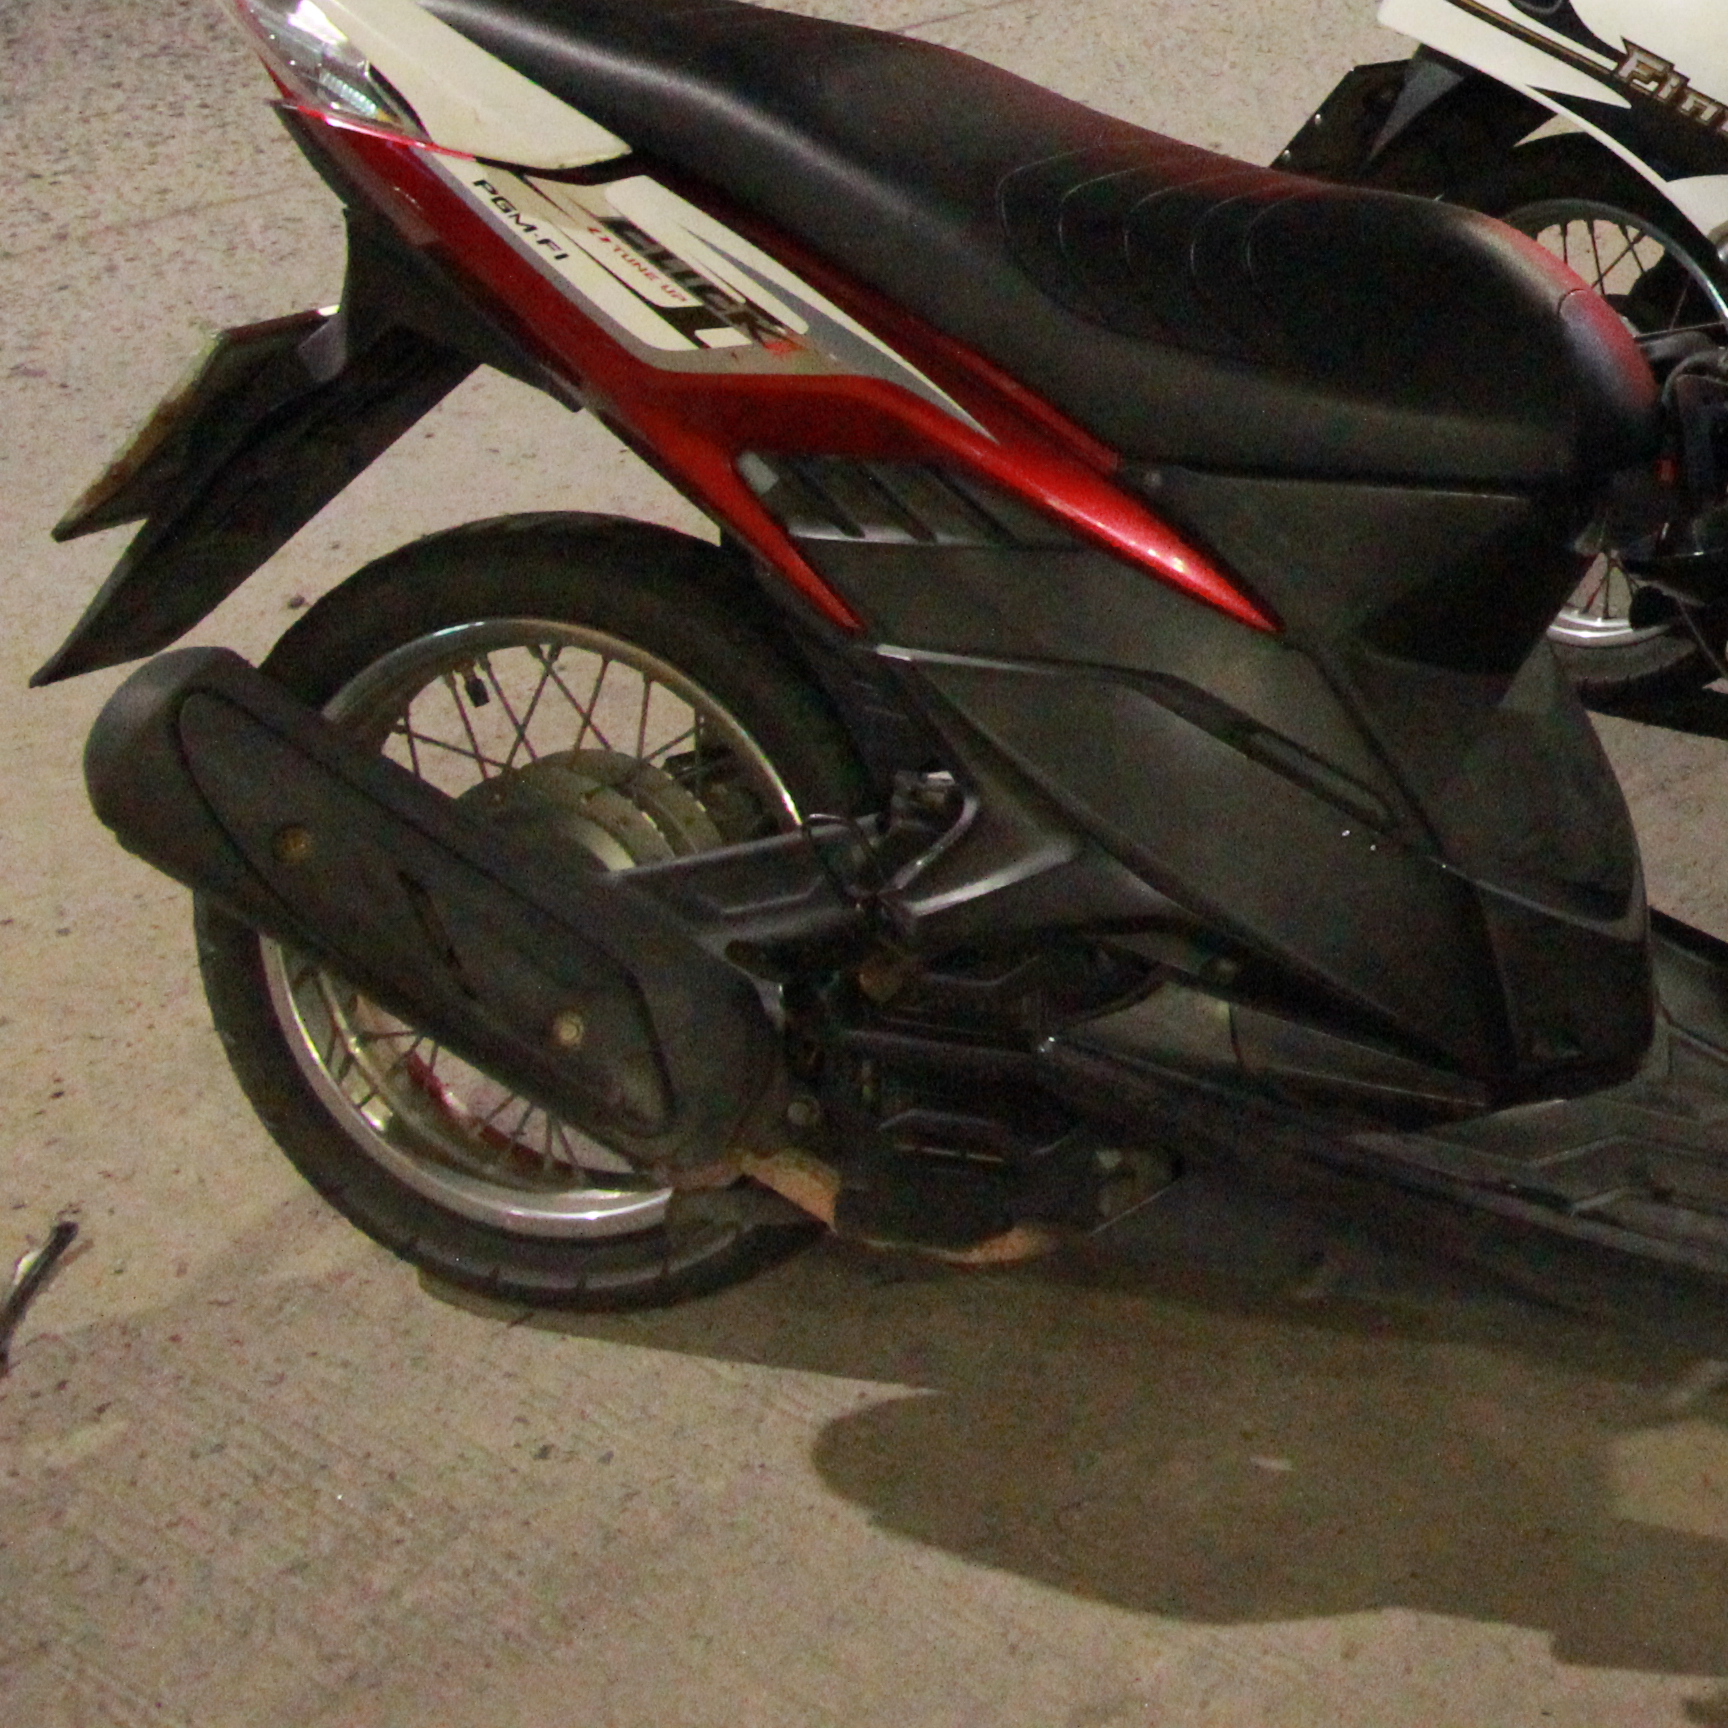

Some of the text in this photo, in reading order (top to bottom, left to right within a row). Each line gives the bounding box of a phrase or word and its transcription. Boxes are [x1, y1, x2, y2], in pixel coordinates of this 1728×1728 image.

[472, 178, 570, 261] PGM-FI
[613, 245, 688, 303] TUNE UP
